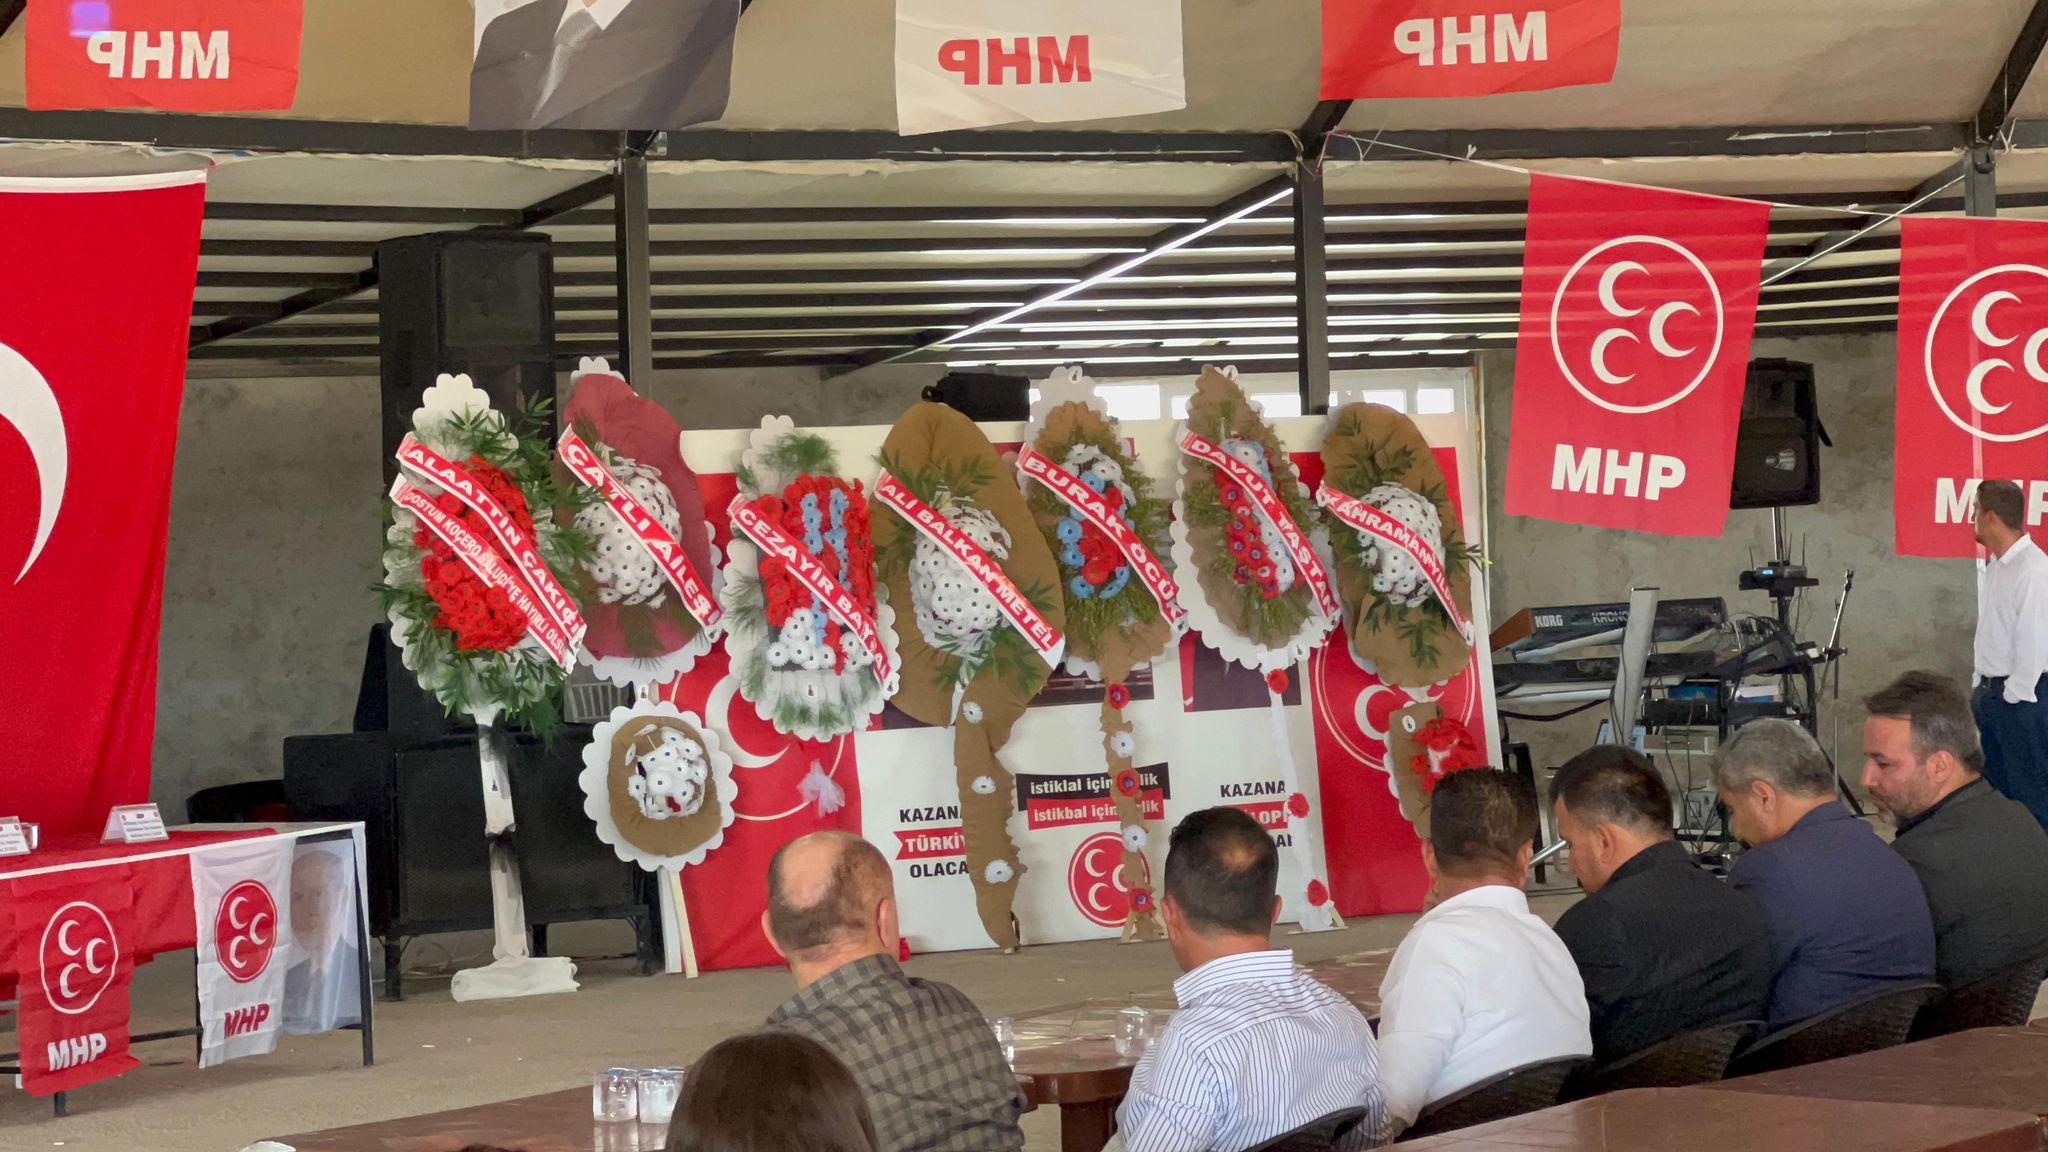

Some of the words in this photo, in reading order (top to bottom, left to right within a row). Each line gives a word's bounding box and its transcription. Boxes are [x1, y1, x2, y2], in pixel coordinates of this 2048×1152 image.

[567, 444, 651, 532] ÇATLI
[1191, 440, 1275, 504] DAVUT
[1551, 443, 1686, 501] MHP
[1025, 457, 1125, 538] BURAK
[1935, 477, 2048, 526] MP
[405, 492, 447, 524] DOSTUM
[443, 518, 483, 556] KOÇERO
[917, 509, 996, 583] BALKAN
[740, 509, 834, 596] CEZAYİR
[1534, 615, 1564, 628] KORG
[1592, 611, 1631, 624] KRONO
[1030, 778, 1082, 795] istiklal
[1220, 780, 1286, 798] KAZANA
[899, 805, 962, 823] KAZAN
[1034, 805, 1087, 822] istikbal
[910, 861, 970, 878] OLACA
[224, 1003, 270, 1040] MHP
[47, 1033, 107, 1072] MHP
